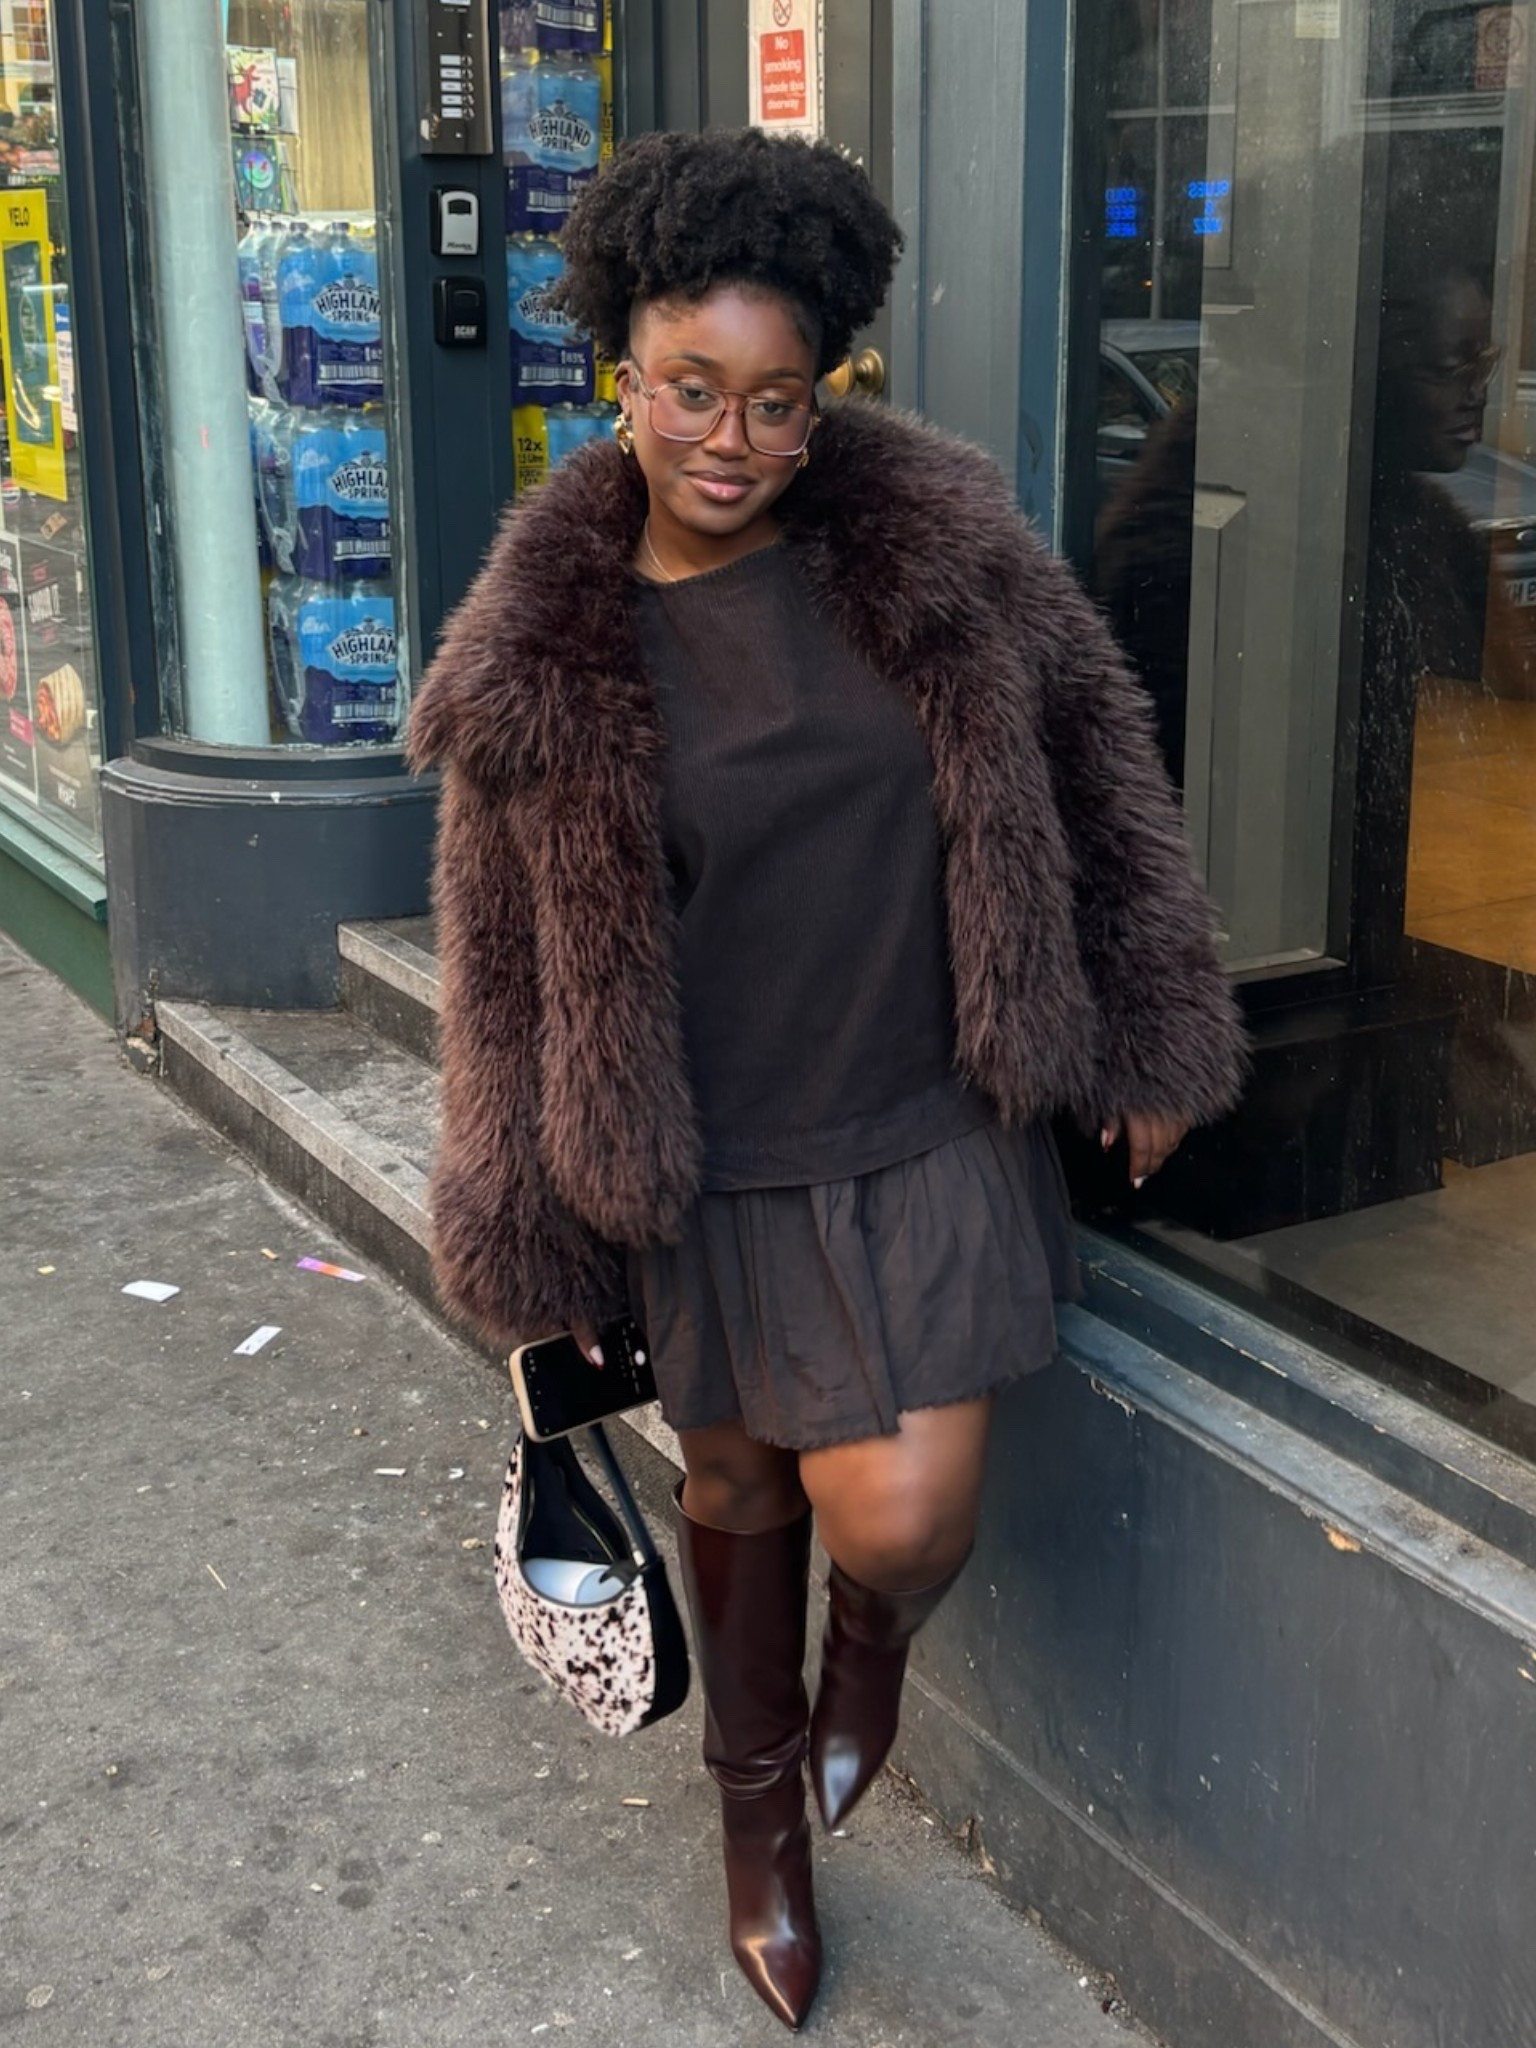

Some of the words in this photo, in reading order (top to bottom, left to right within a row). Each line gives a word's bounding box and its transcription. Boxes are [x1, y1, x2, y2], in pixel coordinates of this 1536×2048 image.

[774, 36, 789, 50] No
[764, 58, 801, 74] smoking
[529, 119, 592, 147] HIGHLAND
[542, 136, 575, 151] SPRING
[315, 292, 381, 315] HIGHLAN
[332, 310, 370, 323] SPRING
[517, 438, 542, 452] 12x
[331, 469, 388, 493] HIGHLA
[348, 486, 388, 499] SPRING
[331, 636, 396, 659] HIGHLAN
[350, 652, 389, 665] SPRING
